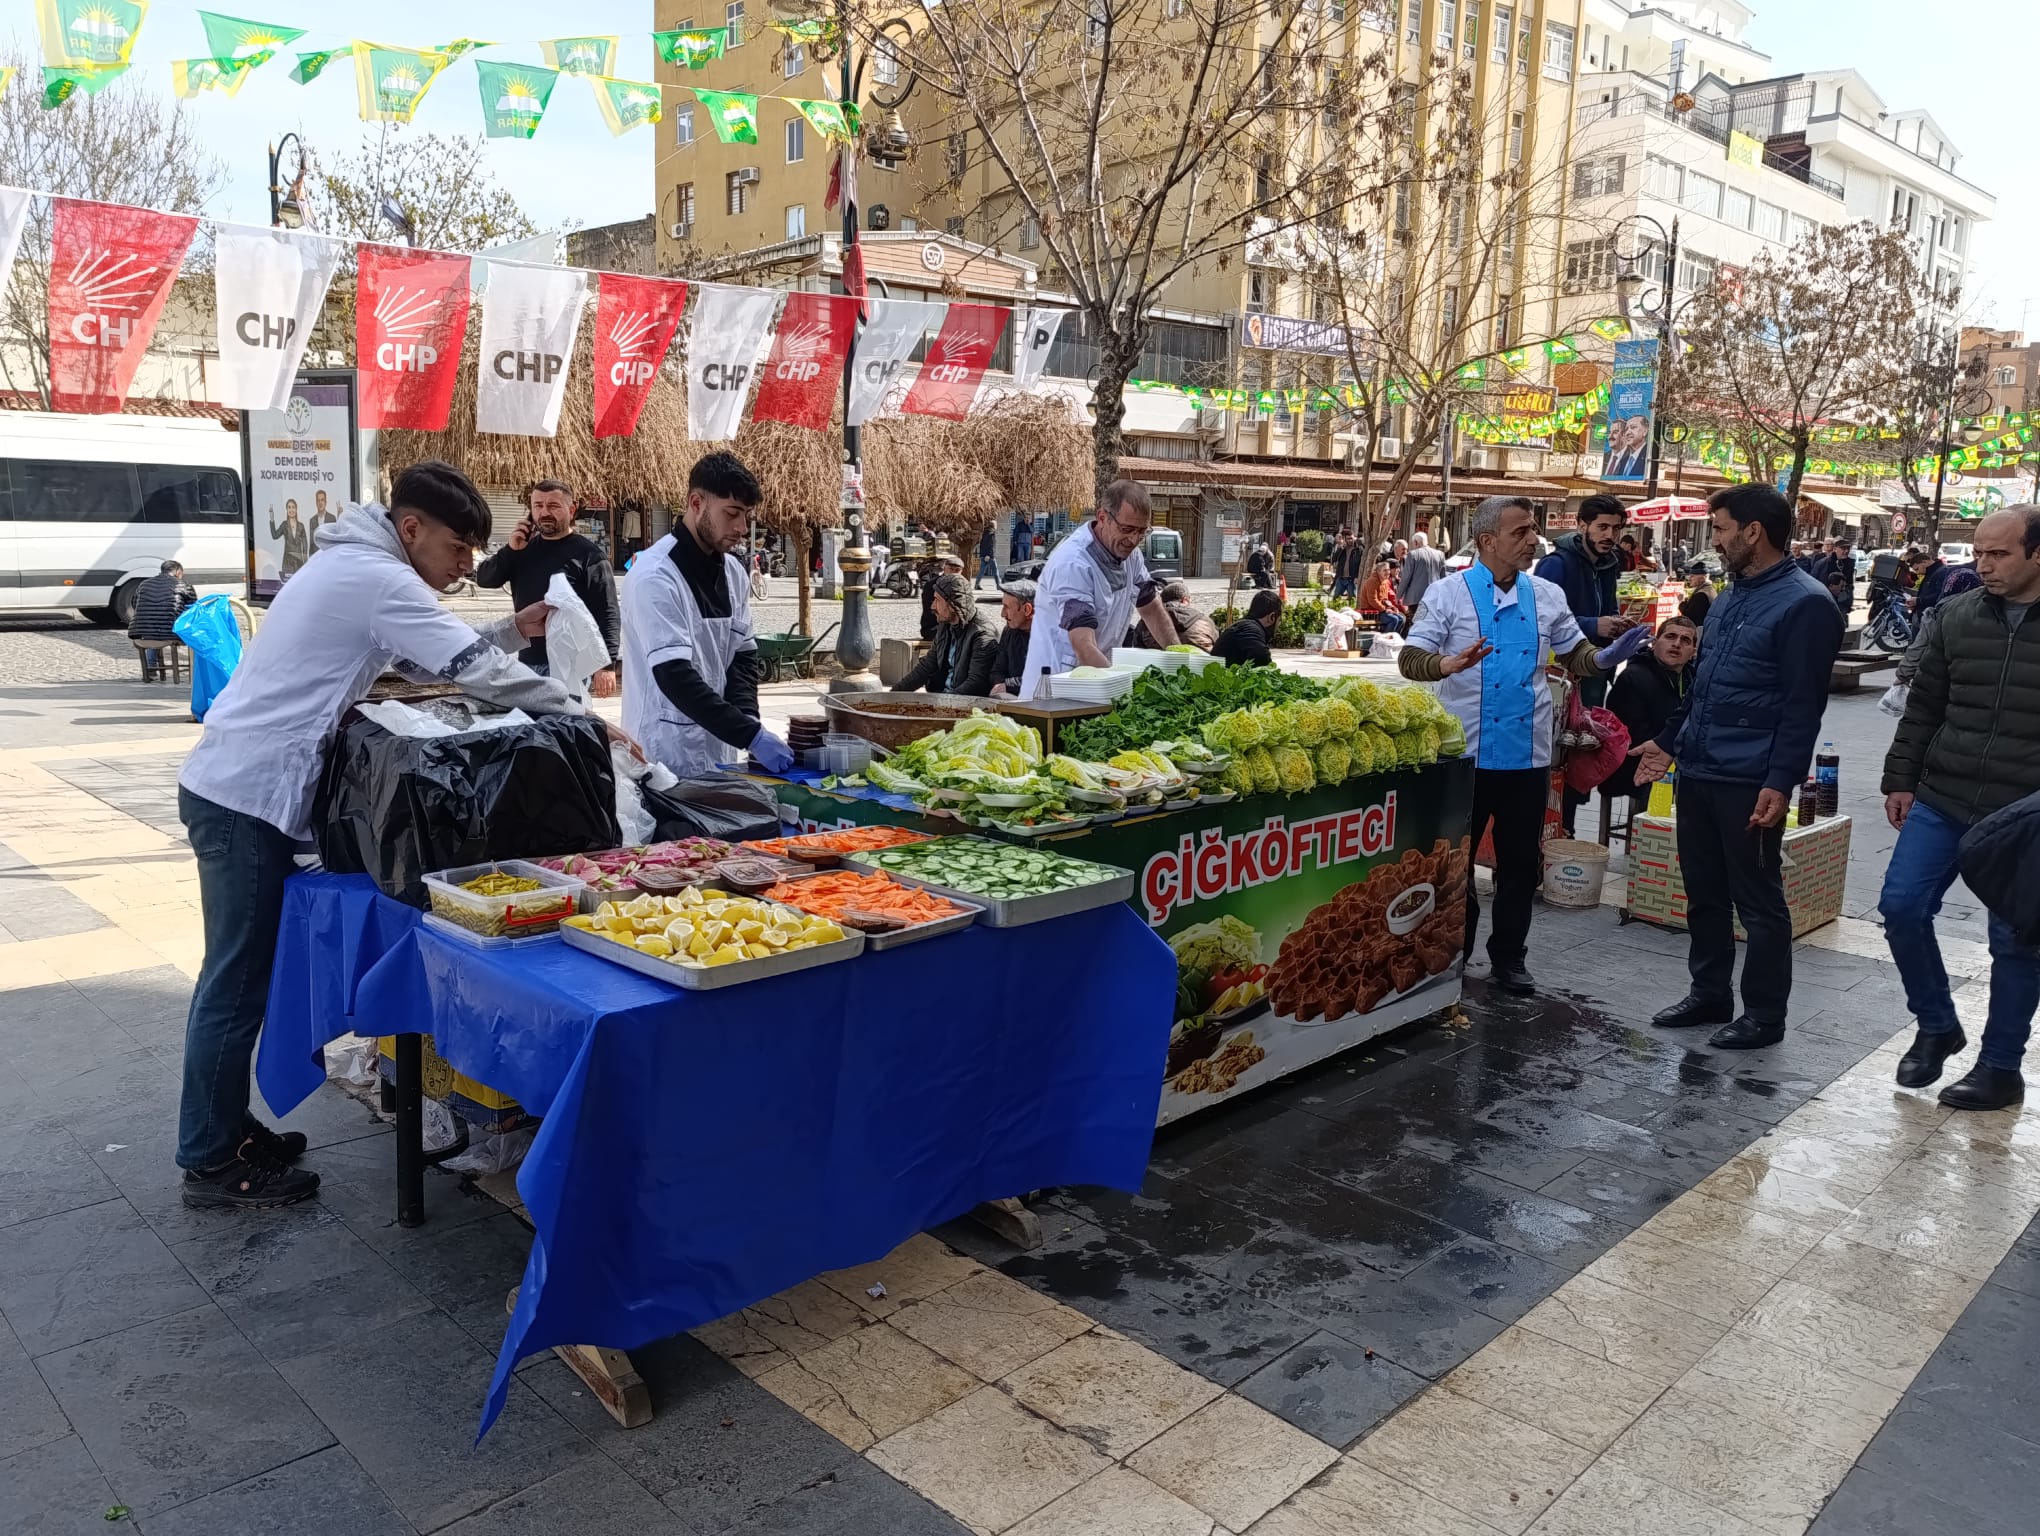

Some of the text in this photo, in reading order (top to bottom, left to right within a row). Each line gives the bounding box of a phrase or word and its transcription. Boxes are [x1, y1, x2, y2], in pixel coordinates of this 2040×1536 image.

[376, 342, 438, 374] CHP
[493, 350, 564, 385] CHP
[610, 361, 655, 387] CHP
[702, 362, 749, 392] CHP
[775, 360, 820, 382] CHP
[929, 363, 970, 384] CHP
[274, 454, 318, 467] DEM DEMÊ
[321, 471, 335, 482] YO
[1642, 508, 1665, 516] ALGIDA
[1144, 792, 1399, 922] ÇİĞKÖFTECİ
